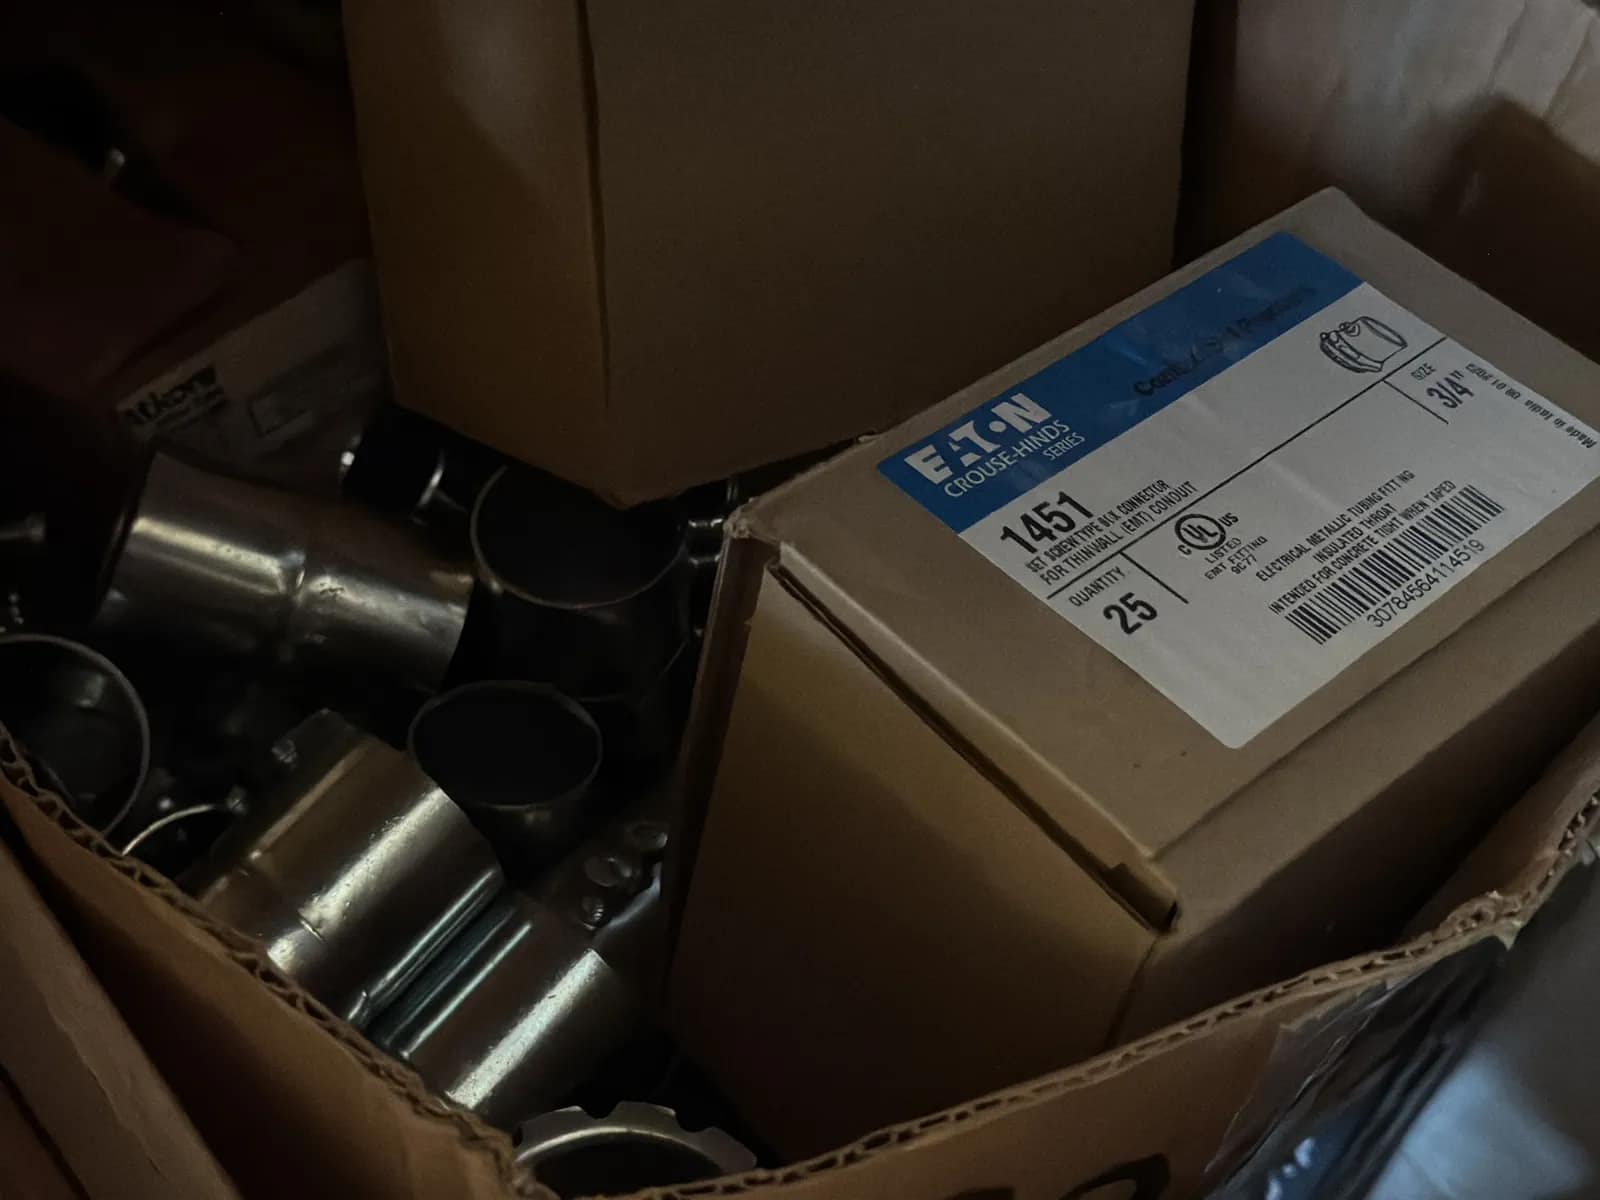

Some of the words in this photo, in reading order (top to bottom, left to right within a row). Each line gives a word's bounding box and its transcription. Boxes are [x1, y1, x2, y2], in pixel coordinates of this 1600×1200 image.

[1410, 363, 1437, 381] SIZE
[1524, 399, 1553, 422] India
[1553, 417, 1566, 429] in
[944, 419, 1071, 498] CROUSE-HINDS
[1043, 431, 1086, 461] SERIES
[1566, 425, 1597, 448] Made
[1001, 491, 1093, 554] 1451
[1025, 553, 1049, 573] SET
[1043, 527, 1083, 560] SCREW
[1074, 515, 1103, 543] TYPE
[1117, 479, 1171, 516] CONNECTOR
[1040, 561, 1069, 586] FOR
[1062, 530, 1124, 572] THINWALL
[1120, 510, 1155, 537] (EMT)
[1148, 480, 1199, 516] CONDUIT
[1256, 542, 1312, 583] ELECTRICAL
[1305, 514, 1352, 548] METALLIC
[1347, 490, 1384, 519] TUBING
[1313, 525, 1366, 565] INSULATED
[1359, 502, 1398, 535] THROAT
[1204, 537, 1242, 565] LISTED
[1204, 562, 1228, 581] EMT
[1229, 535, 1269, 565] FITTING
[1269, 579, 1318, 617] INTENDED
[1315, 562, 1338, 584] FOR
[1333, 536, 1379, 572] CONCRETE
[1374, 517, 1405, 541] TIGHT
[1399, 498, 1430, 522] WHEN
[1422, 479, 1457, 506] TAPED
[1069, 566, 1126, 607] QUANTITY
[1365, 537, 1486, 630] 30784564114519
[1102, 591, 1158, 635] 25
